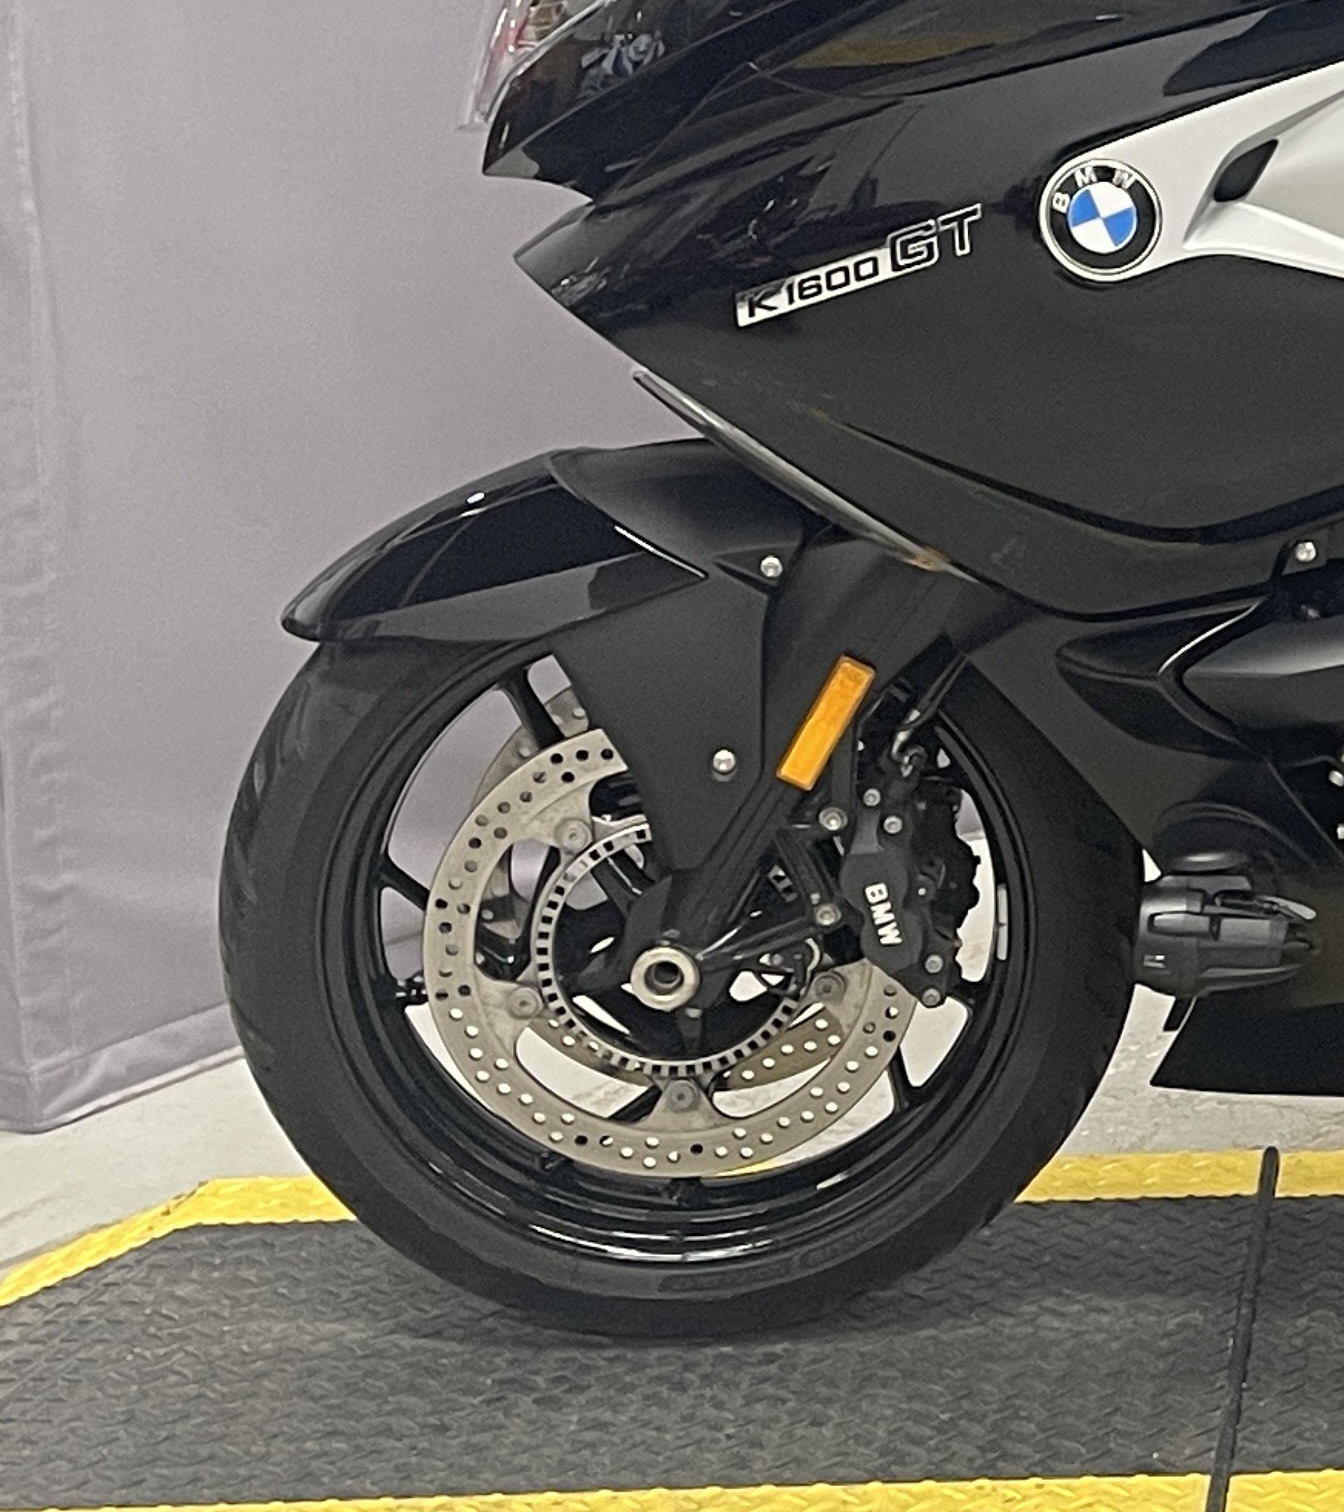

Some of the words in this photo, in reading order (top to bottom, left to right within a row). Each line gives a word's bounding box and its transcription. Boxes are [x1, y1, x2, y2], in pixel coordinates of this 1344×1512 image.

[747, 256, 880, 319] K1600
[886, 202, 983, 276] GT
[865, 883, 902, 945] BMW
